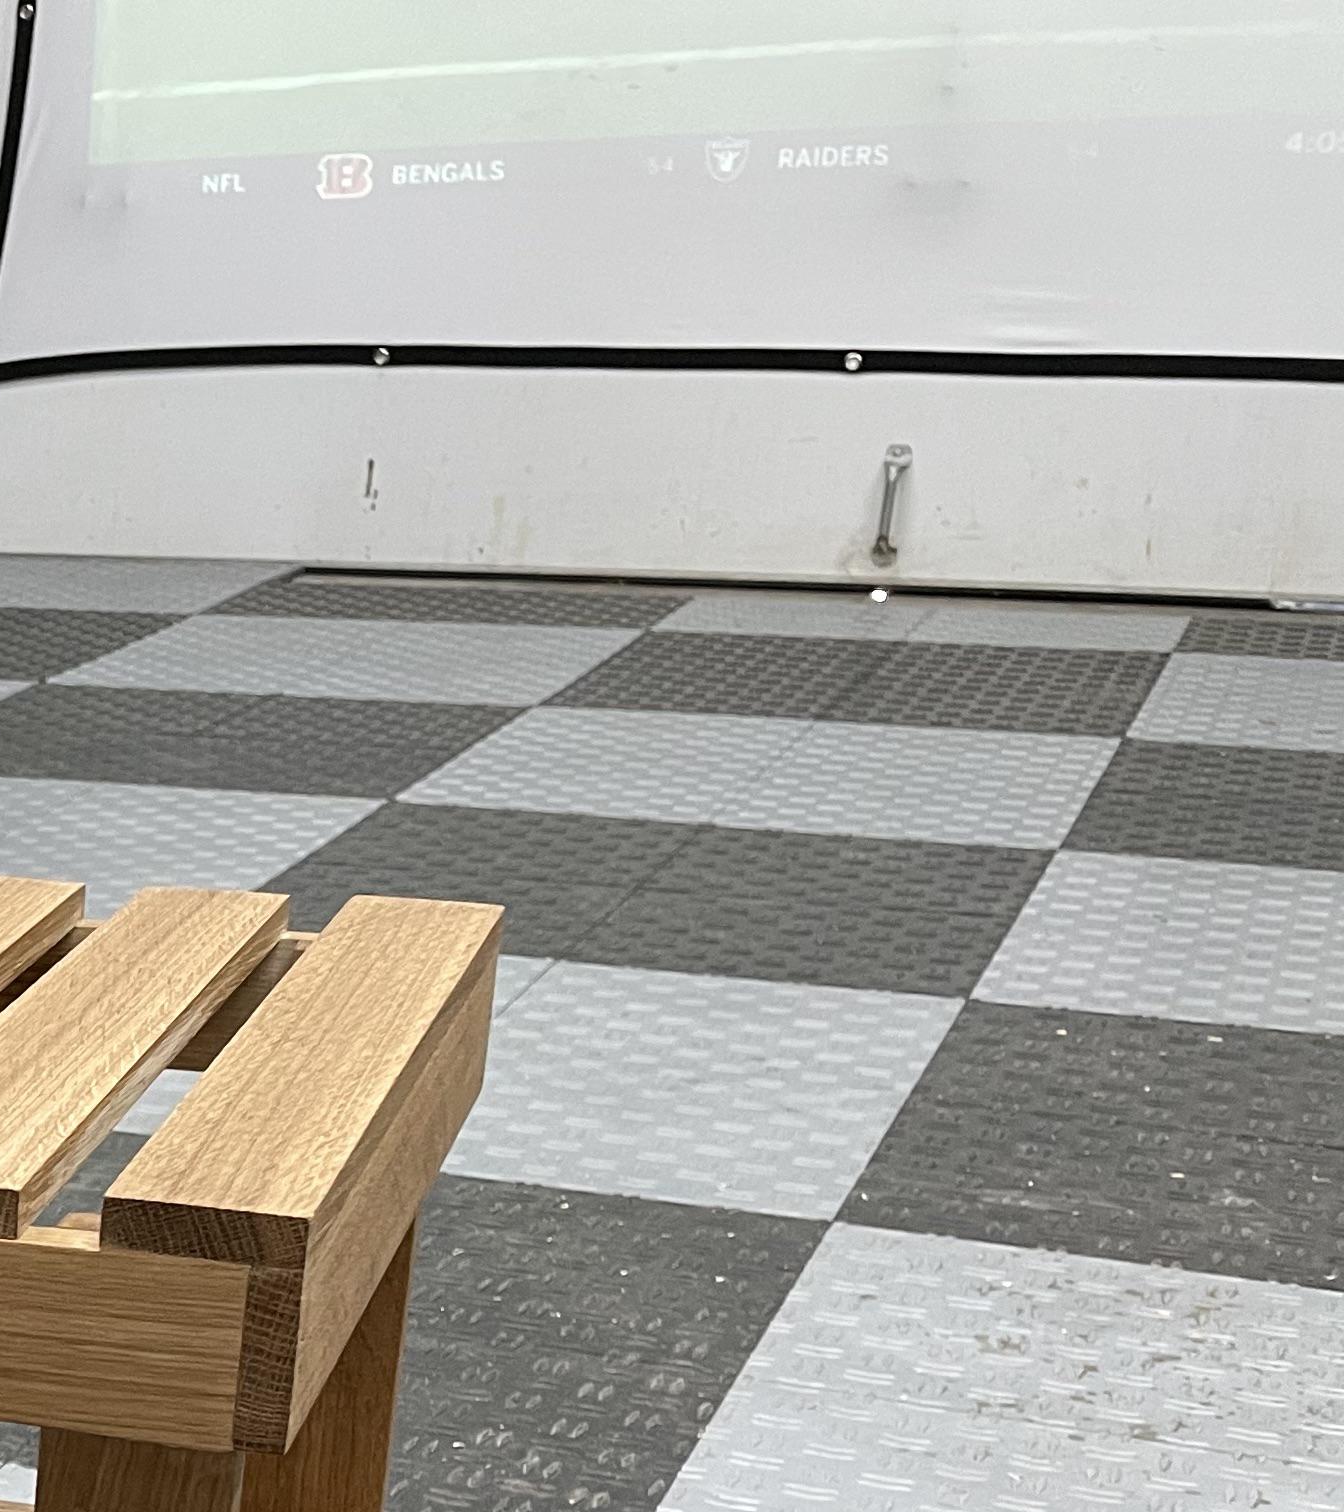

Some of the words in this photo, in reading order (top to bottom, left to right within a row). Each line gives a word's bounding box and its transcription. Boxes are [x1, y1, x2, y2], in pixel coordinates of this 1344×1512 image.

[201, 174, 245, 194] NFL
[392, 161, 505, 185] BENGALS
[778, 145, 889, 170] RAIDERS
[1285, 131, 1344, 154] 4:0
